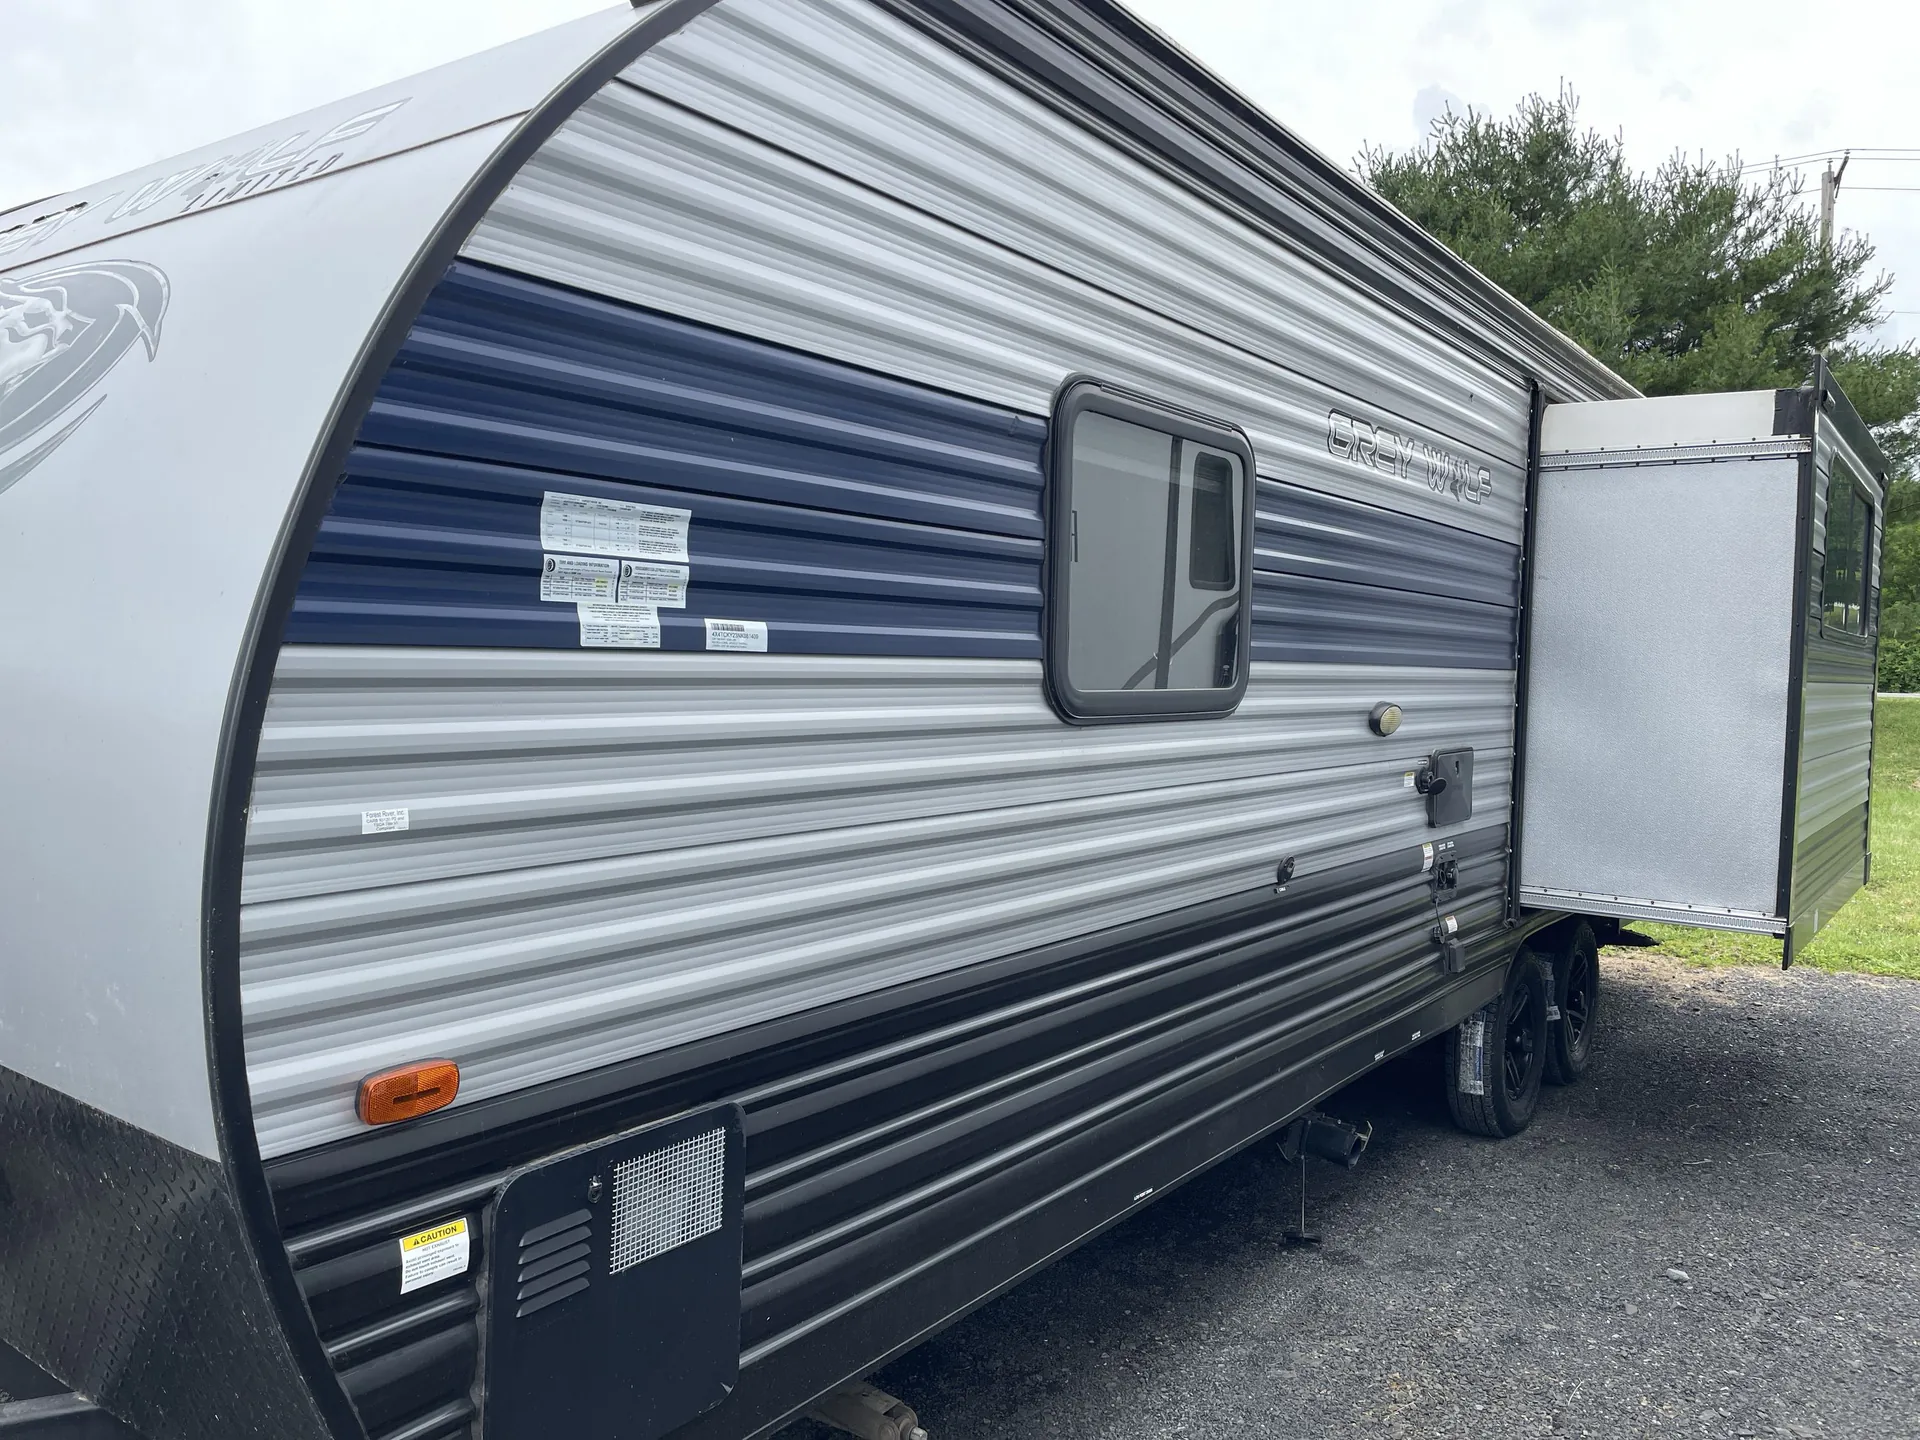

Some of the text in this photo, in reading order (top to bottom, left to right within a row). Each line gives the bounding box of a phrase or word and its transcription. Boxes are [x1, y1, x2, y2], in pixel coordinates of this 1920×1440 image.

[180, 152, 344, 214] LIMITED
[1327, 407, 1415, 480] GREY
[420, 1225, 457, 1243] CAUTION
